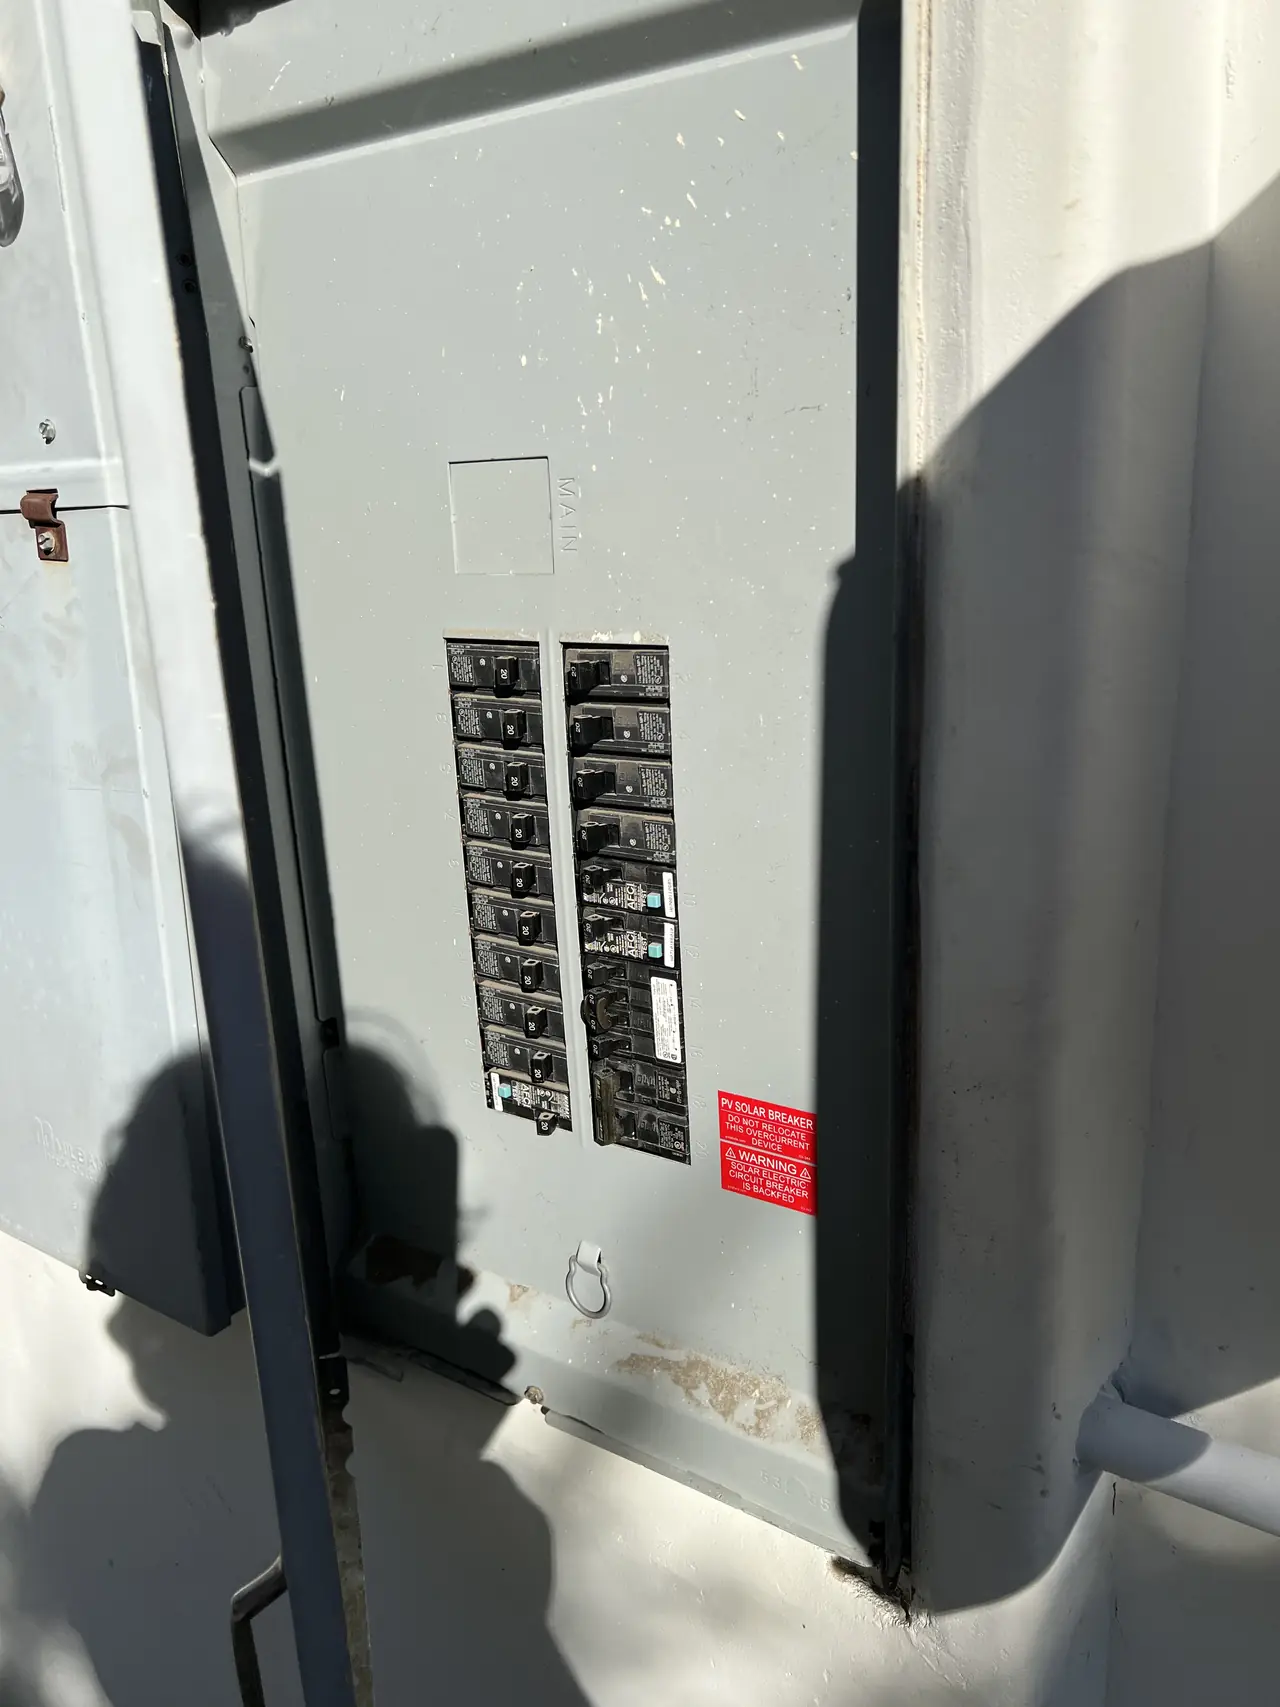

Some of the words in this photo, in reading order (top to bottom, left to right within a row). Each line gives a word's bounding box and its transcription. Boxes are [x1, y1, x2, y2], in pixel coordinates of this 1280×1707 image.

[558, 478, 577, 551] MAIN
[500, 668, 508, 680] 20
[506, 724, 514, 735] 20
[510, 776, 519, 787] 20
[515, 828, 523, 839] 20
[515, 878, 523, 888] 20
[626, 883, 637, 910] AFCI
[522, 925, 530, 936] 20
[627, 931, 638, 958] AFCI
[524, 975, 532, 985] 20
[528, 1021, 536, 1031] 20
[534, 1069, 542, 1079] 20
[521, 1083, 532, 1109] AFCI
[721, 1097, 733, 1110] PV
[735, 1101, 766, 1118] SOLAR
[768, 1109, 814, 1131] BREAKER
[541, 1121, 549, 1131] 20
[725, 1121, 744, 1133] THIS
[746, 1127, 810, 1150] OVERCURRENT
[728, 1113, 740, 1124] DO
[742, 1117, 760, 1129] NOT
[762, 1122, 807, 1141] RELOCATE
[751, 1137, 783, 1153] DEVICE
[738, 1149, 797, 1175] WARNING
[729, 1169, 764, 1186] CIRCUIT
[766, 1180, 809, 1199] BREAKER
[730, 1161, 760, 1176] SOLAR
[762, 1169, 806, 1189] ELECTRIC
[742, 1181, 751, 1191] IS
[753, 1185, 795, 1204] BACKFED
